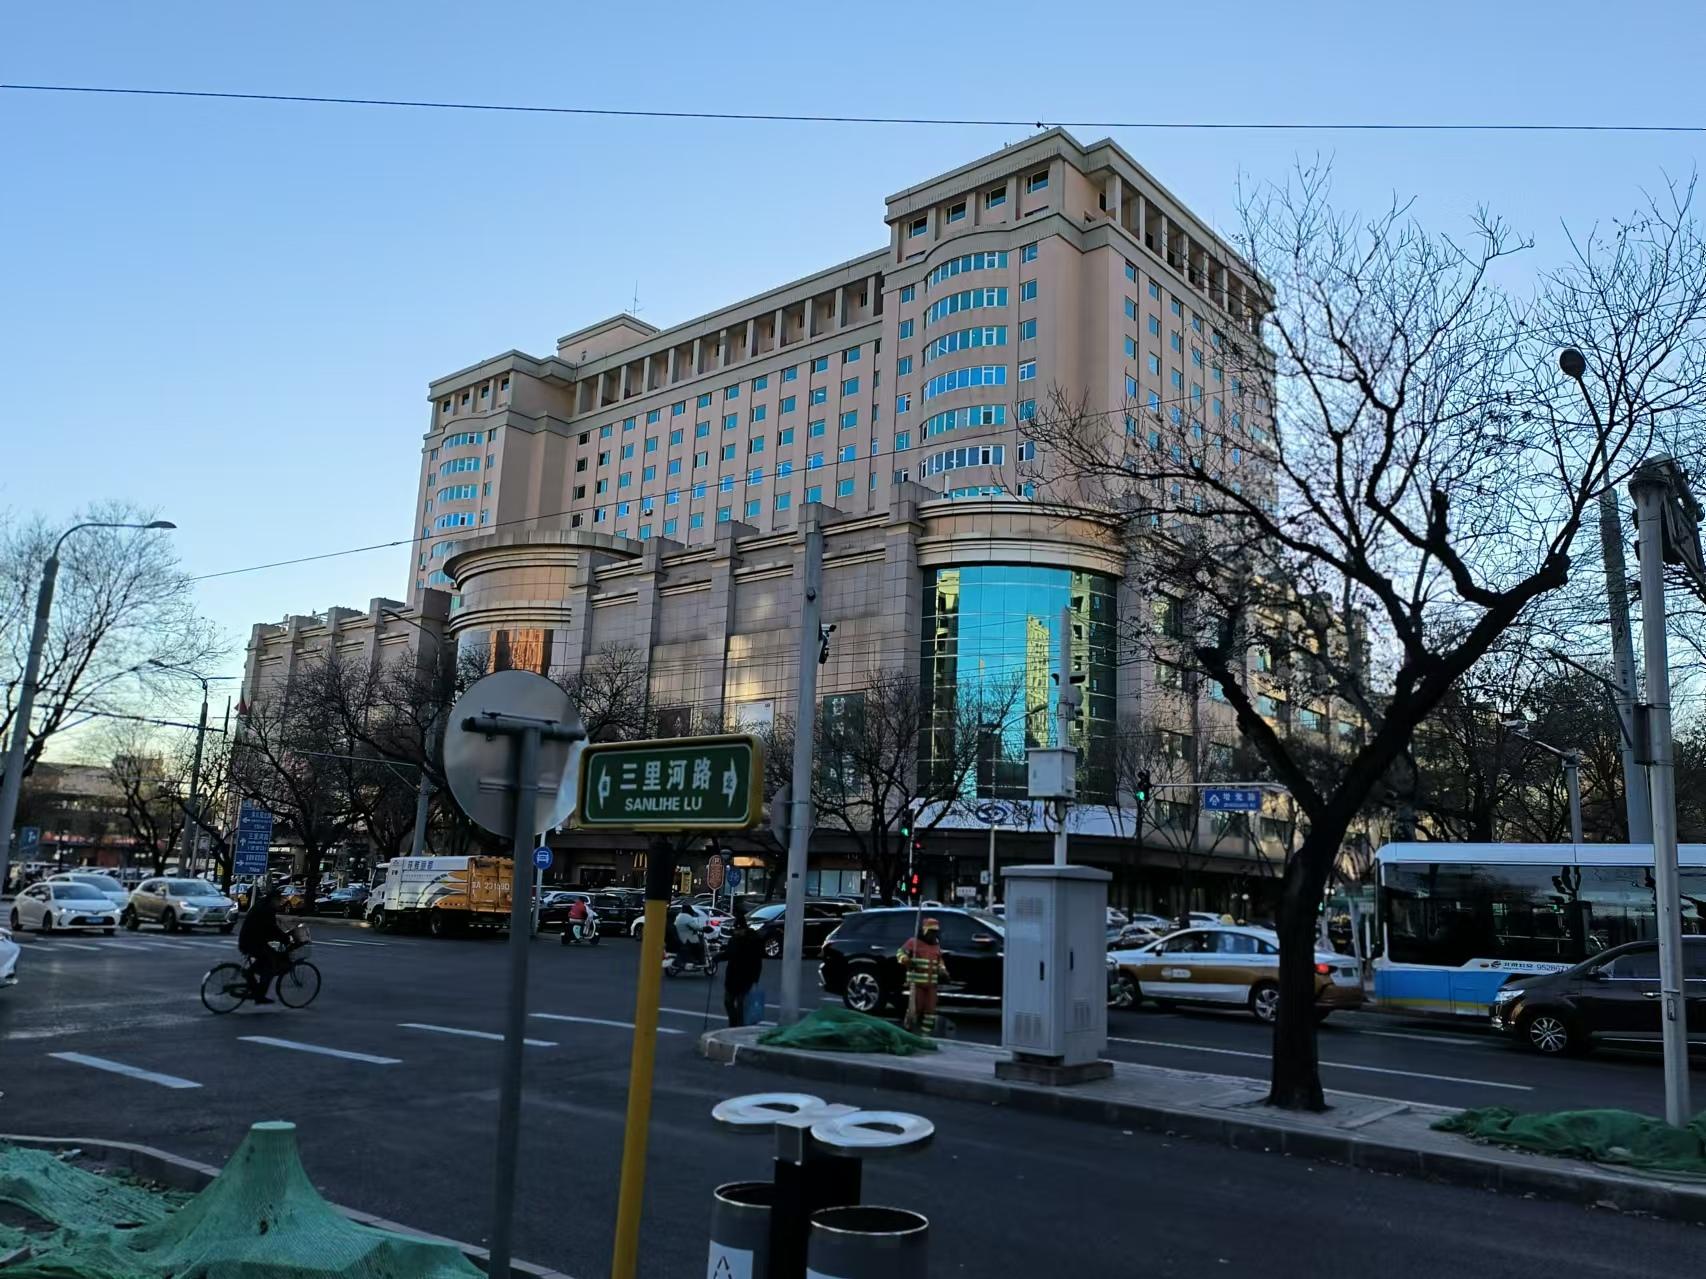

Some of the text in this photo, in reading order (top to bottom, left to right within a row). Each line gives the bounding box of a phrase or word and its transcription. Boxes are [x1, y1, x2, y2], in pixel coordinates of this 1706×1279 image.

[620, 757, 712, 791] 三里河路
[625, 797, 702, 812] SANLIHE LU
